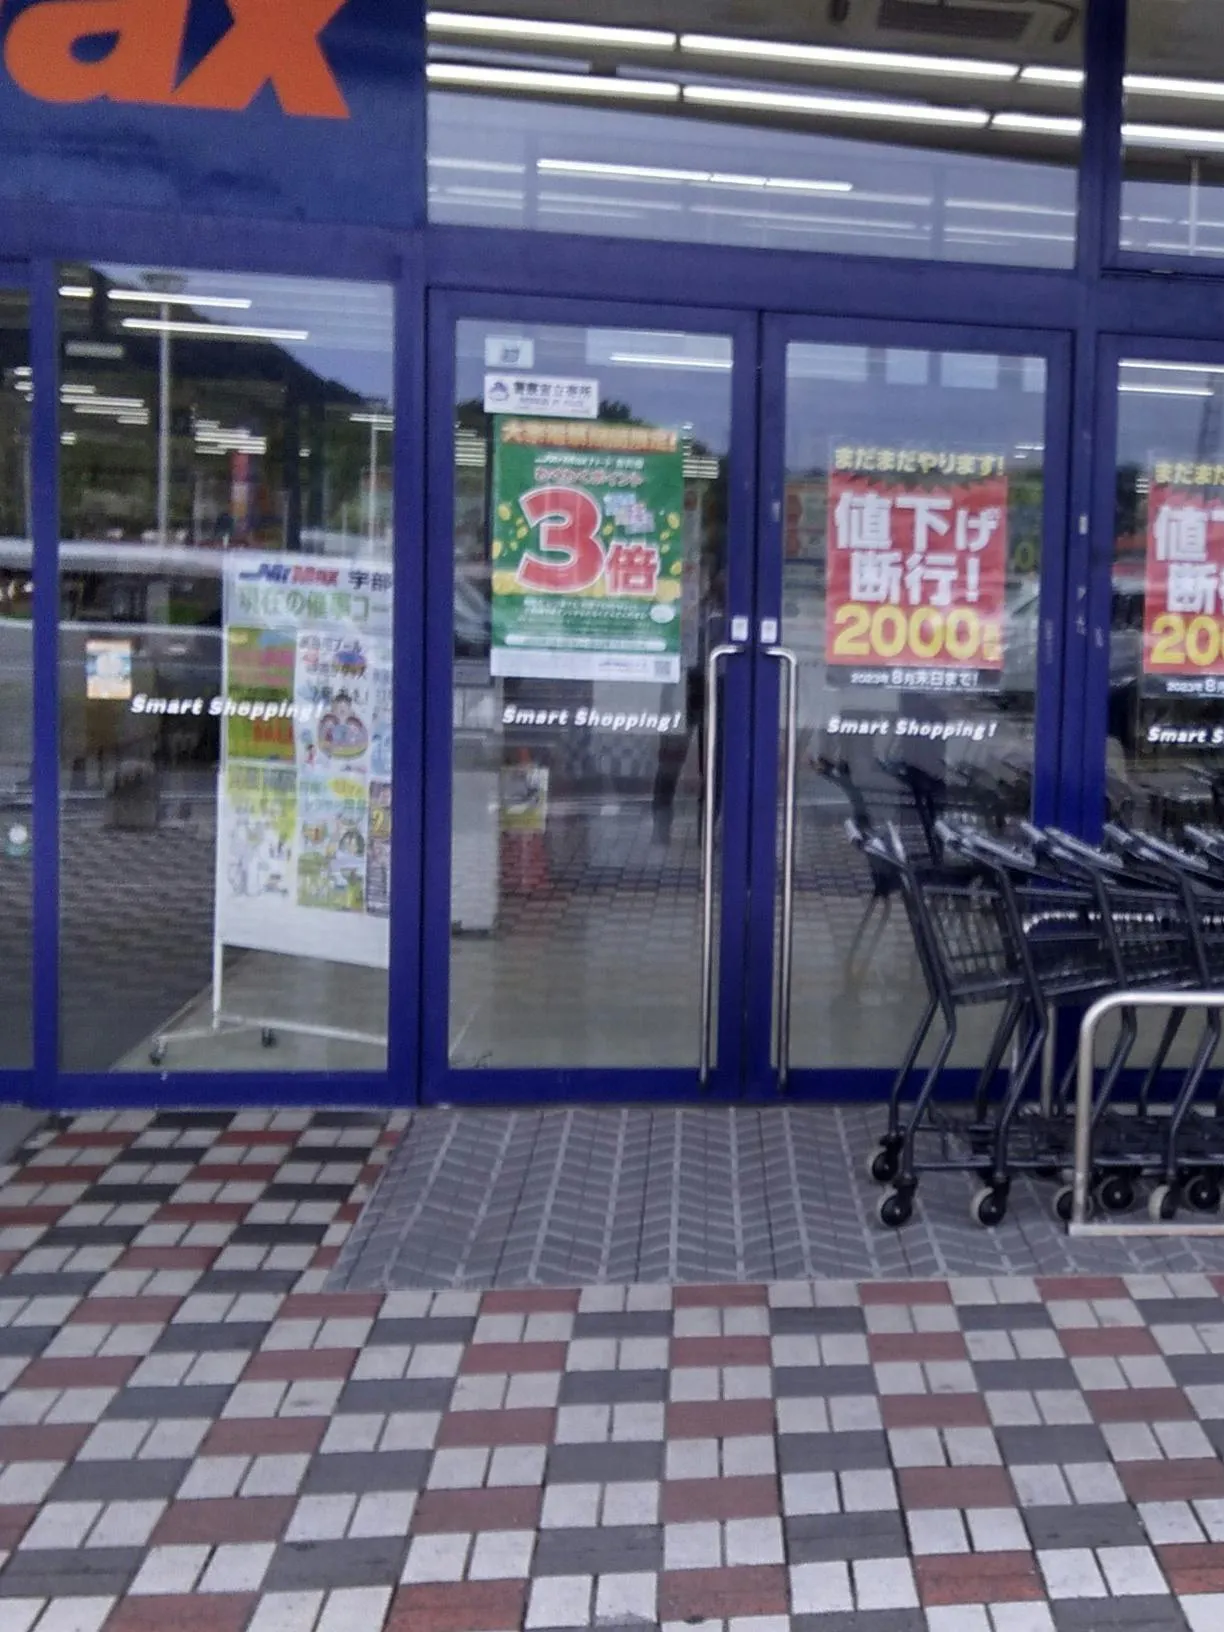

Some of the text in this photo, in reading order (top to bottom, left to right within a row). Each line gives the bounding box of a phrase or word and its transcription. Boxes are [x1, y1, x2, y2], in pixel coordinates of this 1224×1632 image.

[834, 491, 1002, 553] 値下げ
[130, 693, 204, 716] Smart
[208, 695, 325, 722] Shopping!
[502, 704, 682, 732] Smart Shopping!
[827, 716, 998, 742] Smart Shopping!
[1147, 725, 1208, 744] Smart
